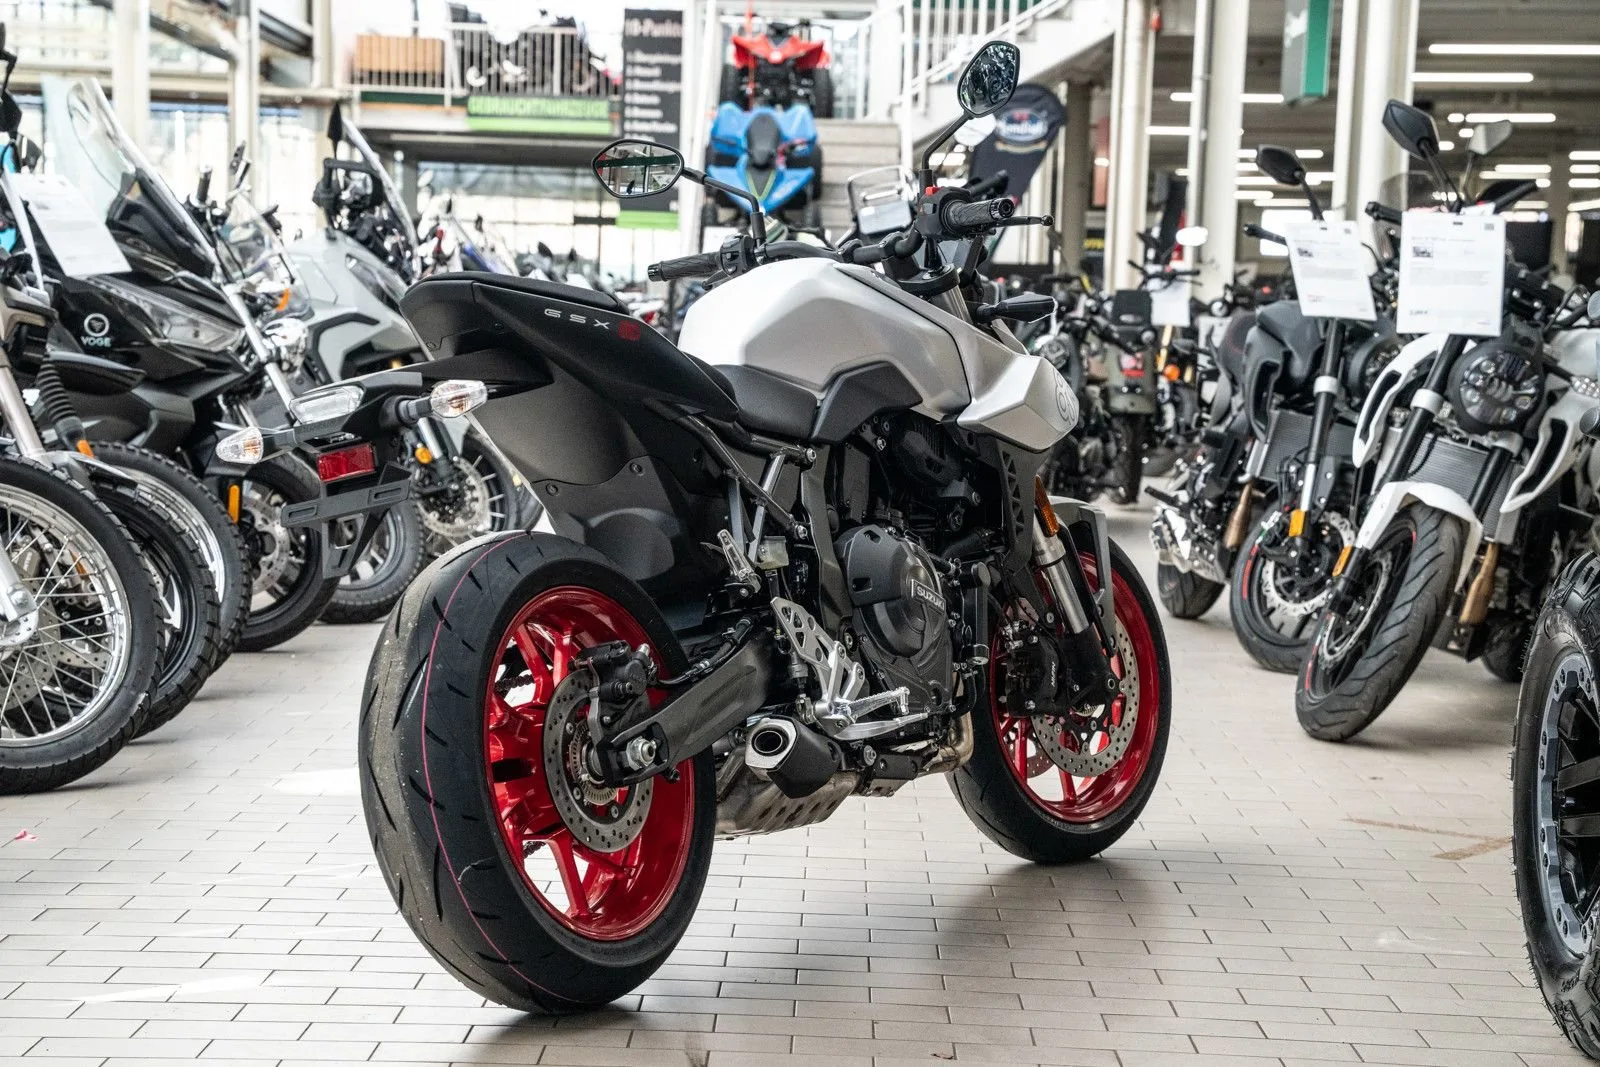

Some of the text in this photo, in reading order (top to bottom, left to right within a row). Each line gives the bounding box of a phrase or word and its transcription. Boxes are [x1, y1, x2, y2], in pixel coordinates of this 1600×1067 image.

[544, 308, 610, 330] GSX
[80, 336, 112, 347] VOGE
[916, 585, 945, 611] SUZUKI
